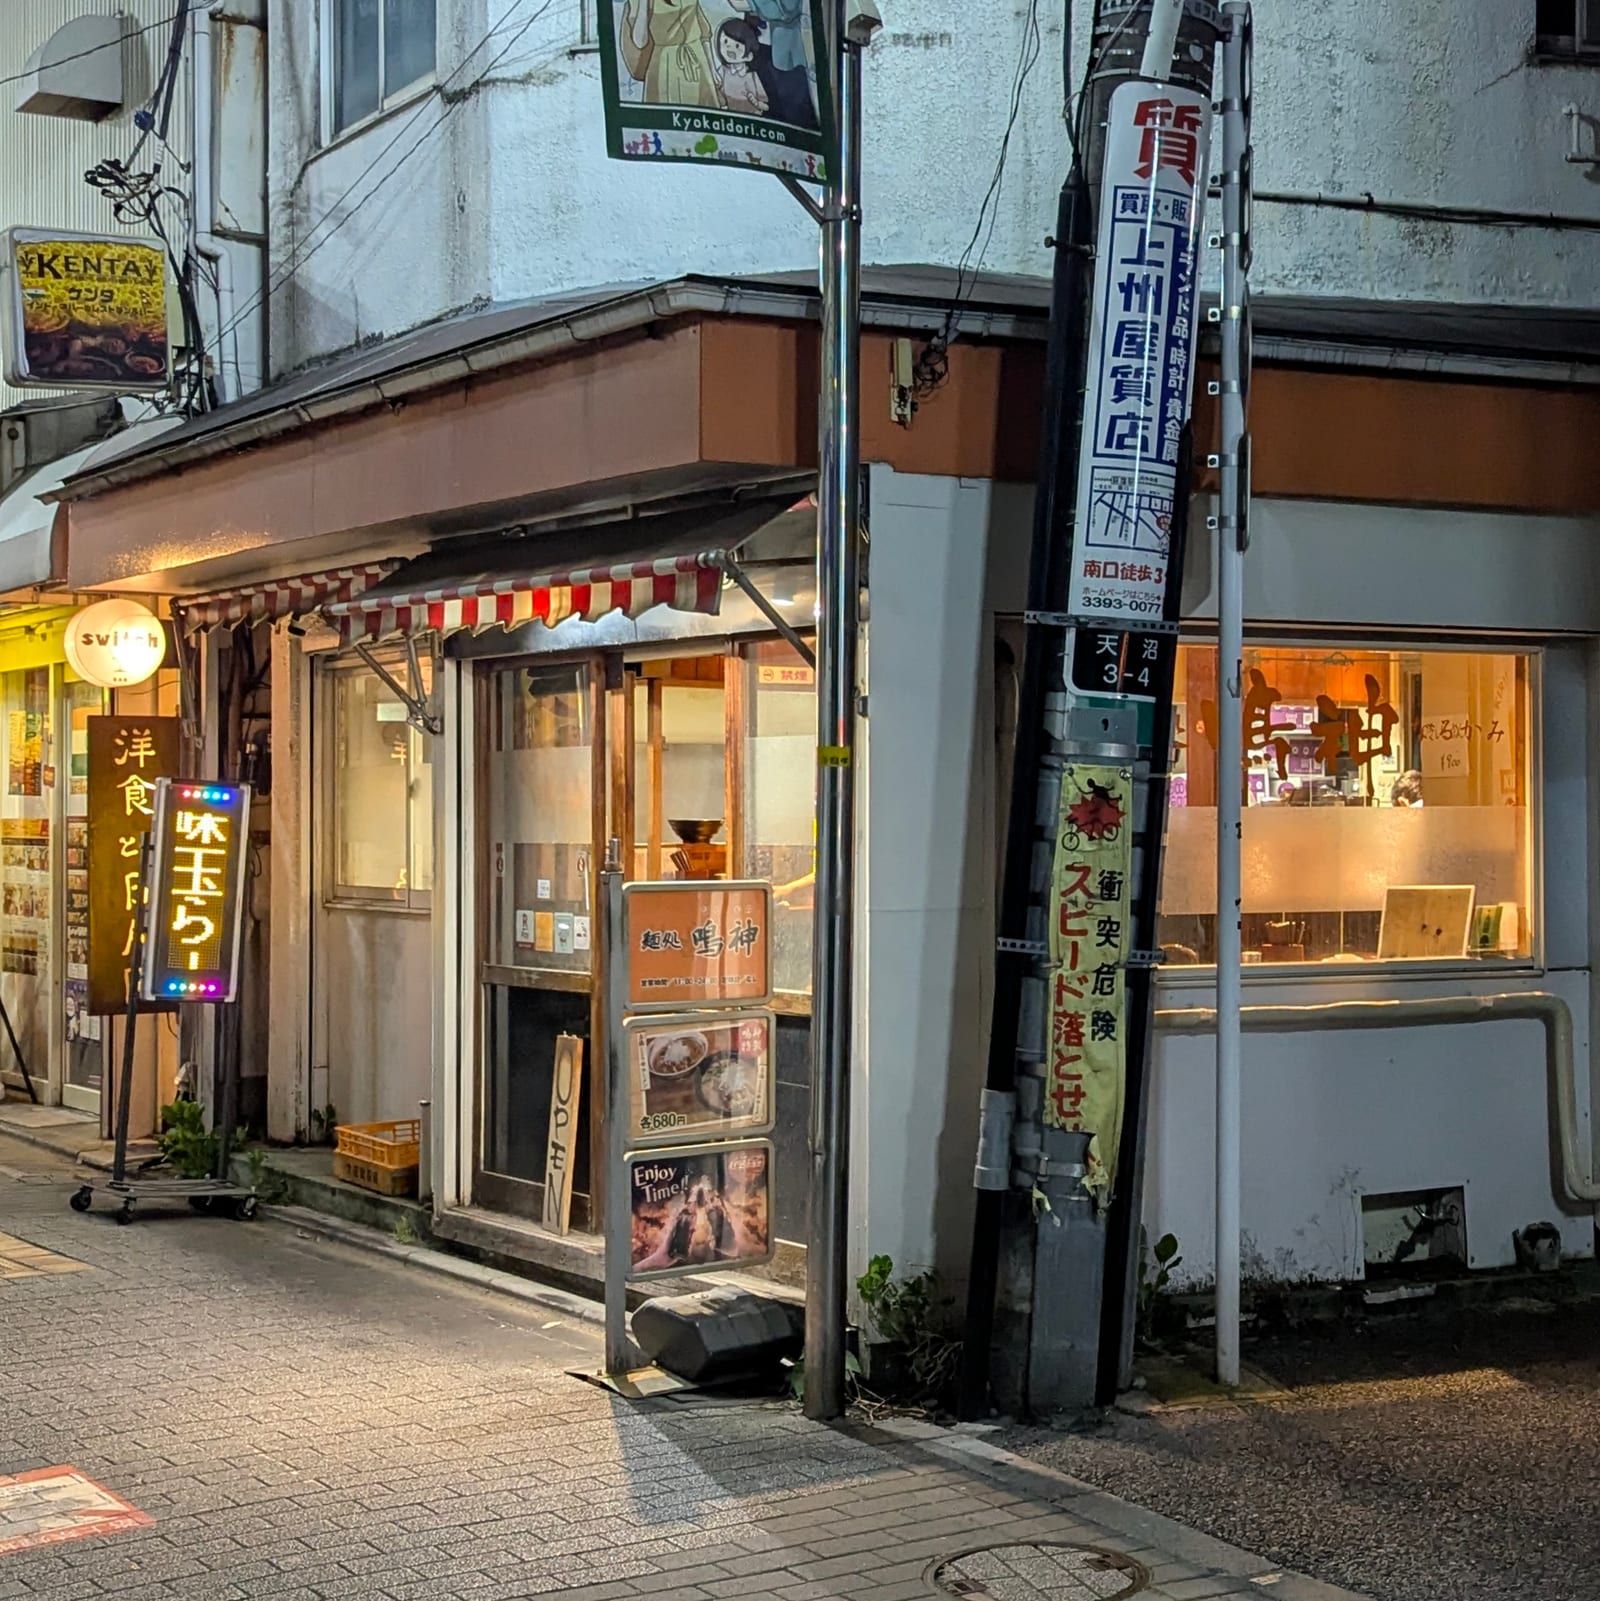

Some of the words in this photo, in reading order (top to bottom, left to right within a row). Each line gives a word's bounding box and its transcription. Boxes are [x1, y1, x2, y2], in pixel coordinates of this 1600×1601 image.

[672, 112, 786, 143] Kyokaidori.com
[1134, 98, 1202, 188] 質
[37, 253, 142, 279] KENTA
[68, 287, 114, 303] ケンタ
[1103, 228, 1165, 453] 上州屋質店
[1082, 596, 1162, 614] 3393-0077
[82, 630, 159, 649] swih
[781, 670, 808, 681] 禁煙
[1103, 663, 1149, 687] 3-4
[641, 931, 682, 950] 麺処
[692, 919, 760, 957] 鳴神
[1091, 869, 1124, 1042] 衝突危険
[640, 1114, 685, 1130] 各680円
[547, 1049, 574, 1229] OPEN
[634, 1165, 677, 1187] Enjoy
[641, 1175, 689, 1203] Time!!
